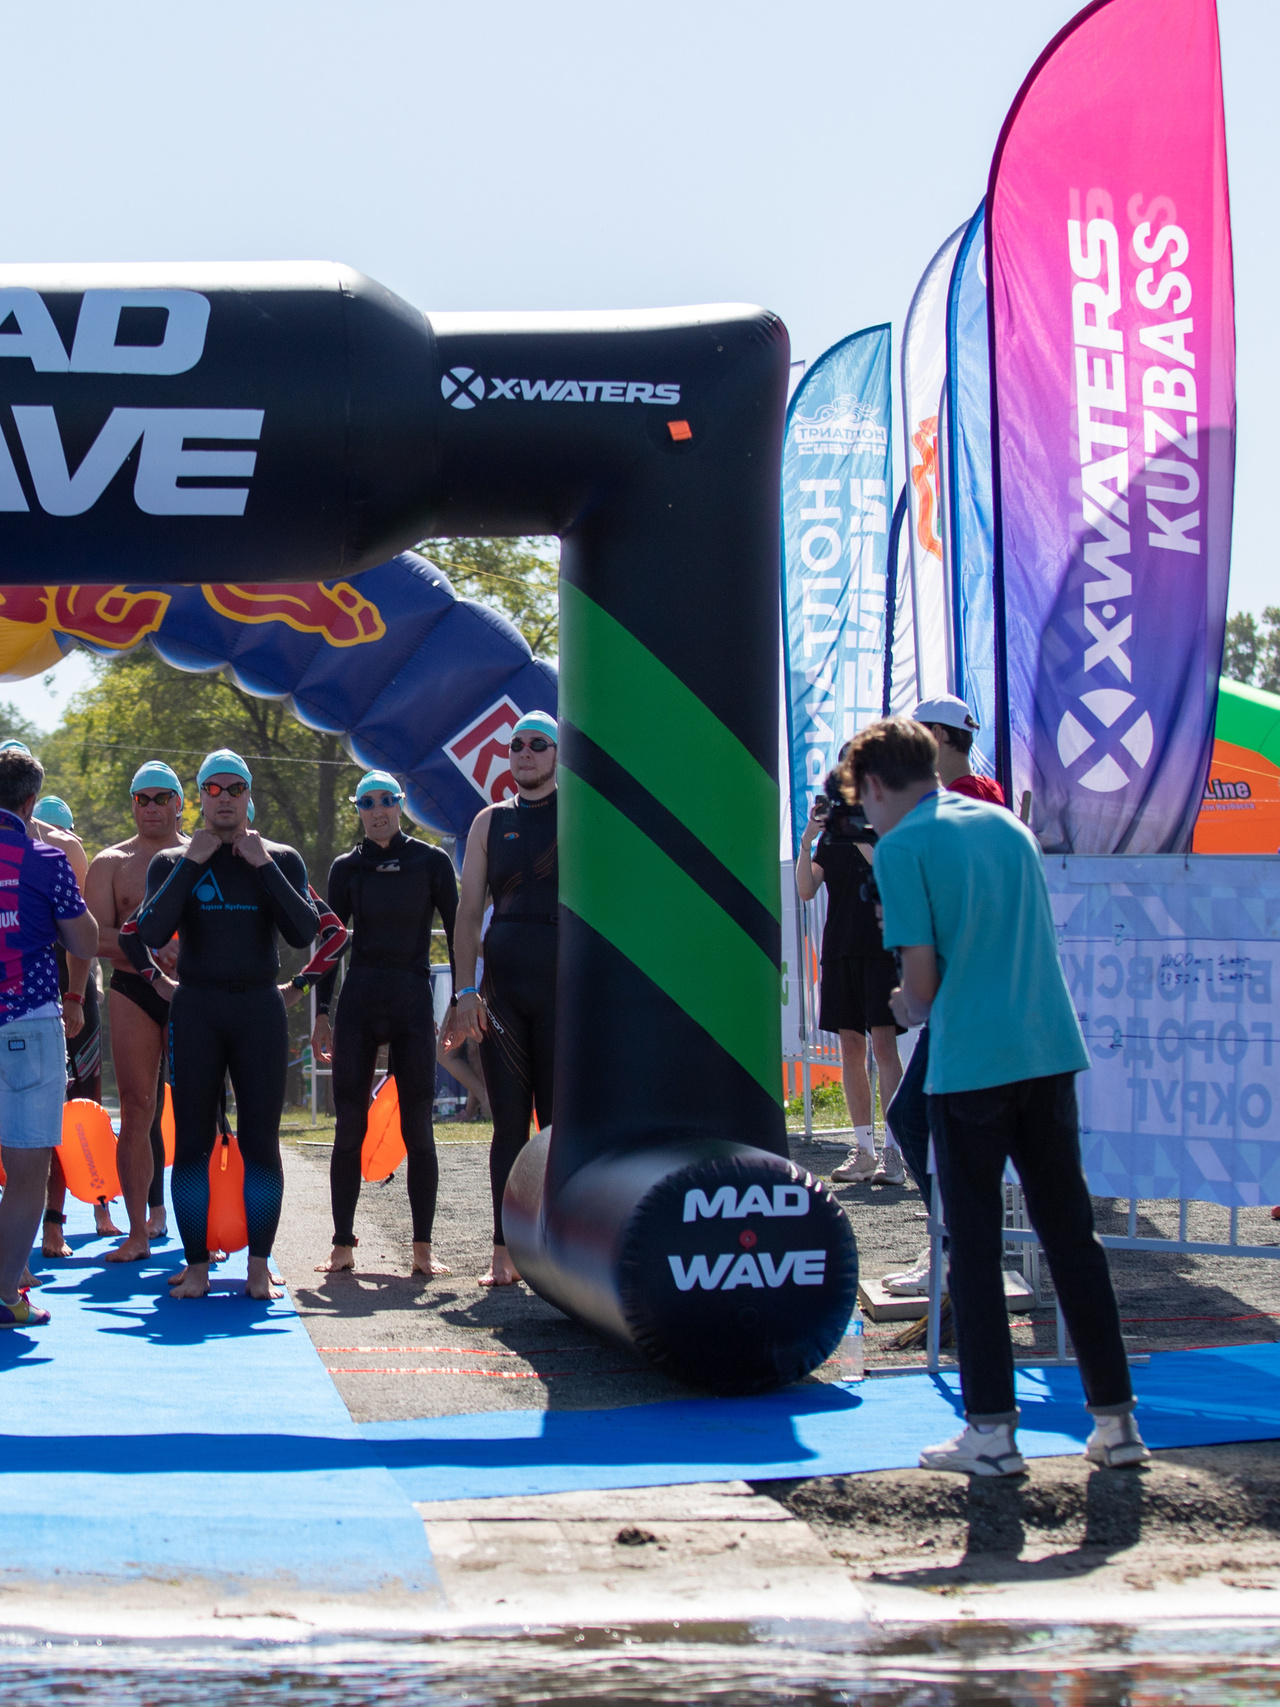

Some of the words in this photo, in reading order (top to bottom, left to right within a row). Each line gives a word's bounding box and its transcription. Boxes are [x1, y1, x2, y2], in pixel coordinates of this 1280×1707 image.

[1131, 221, 1201, 555] KUZBASS
[224, 903, 258, 911] Sphere
[683, 1184, 810, 1223] MAD
[667, 1250, 827, 1291] WAVE
